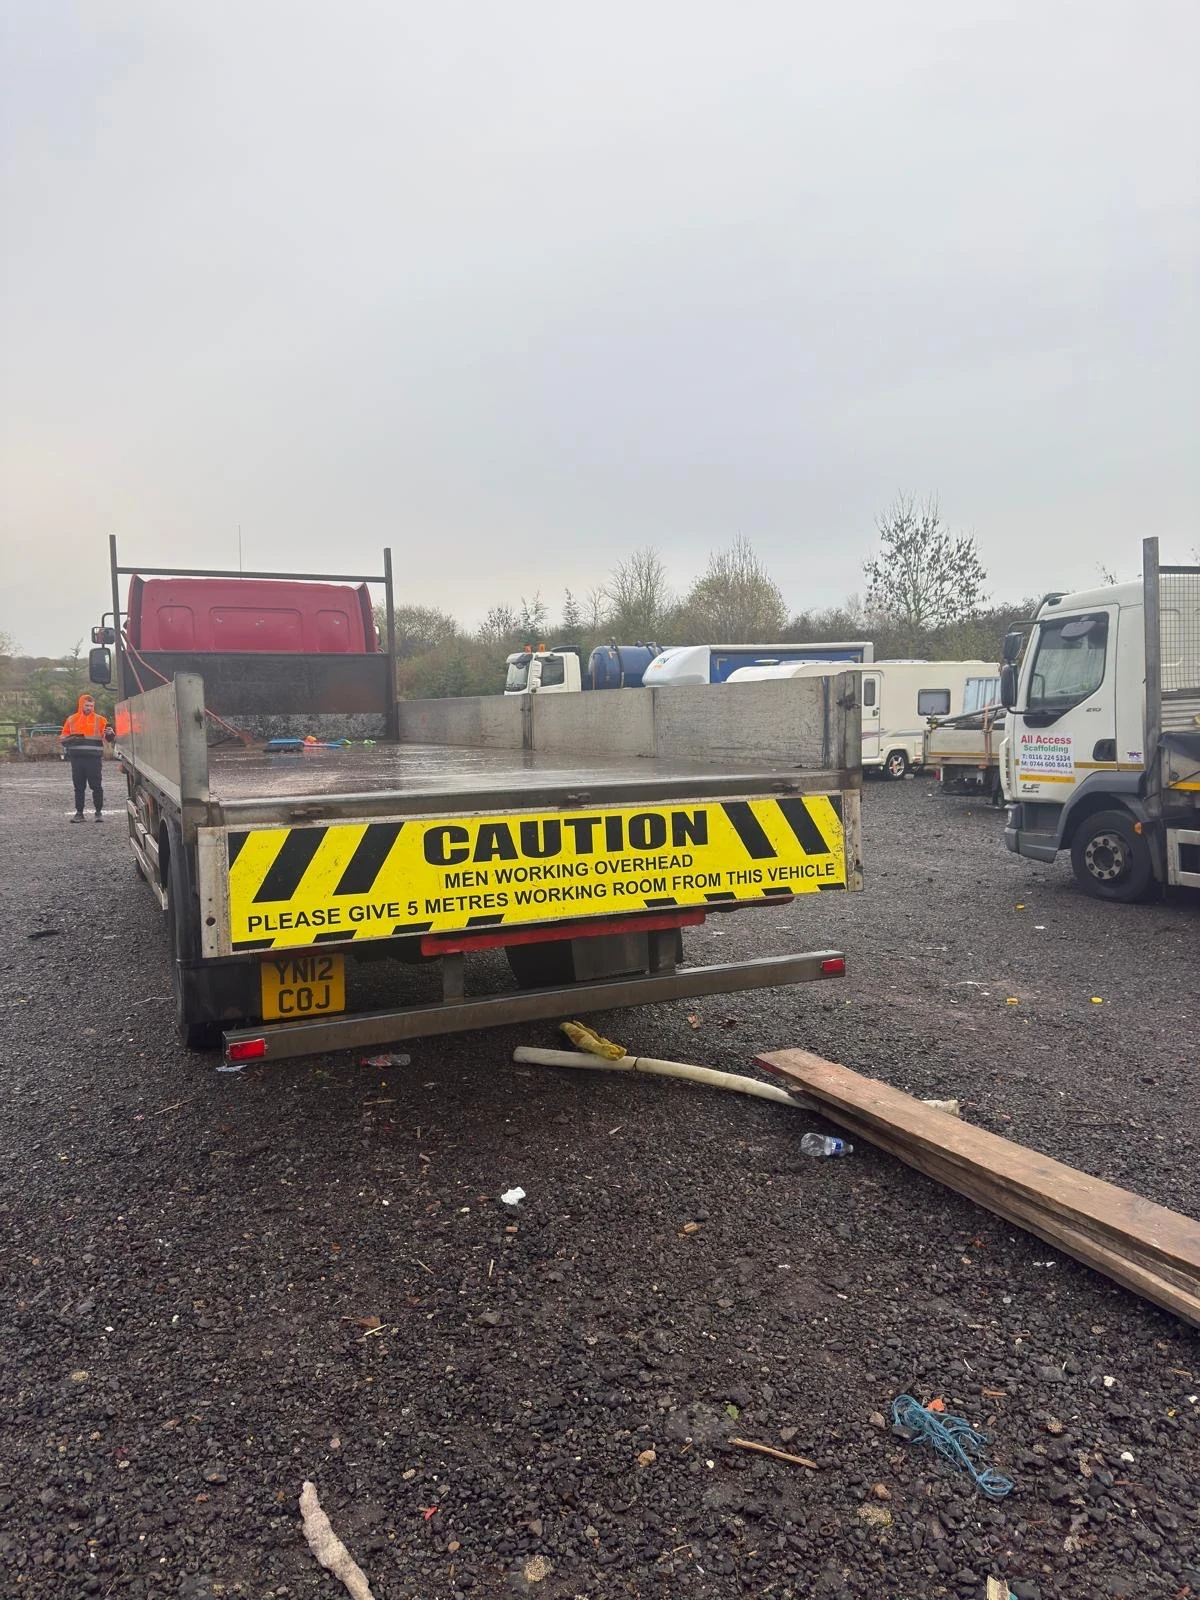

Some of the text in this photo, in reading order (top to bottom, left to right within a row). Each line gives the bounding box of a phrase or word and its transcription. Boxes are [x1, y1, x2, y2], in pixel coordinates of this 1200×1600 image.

[1021, 735, 1072, 745] All Access
[1023, 745, 1069, 754] Scaffolding
[423, 810, 709, 866] CAUTION
[445, 853, 693, 889] MEN WORKING OVERHEAD
[248, 863, 836, 932] PLEASE GIVE 5 METRES WORKING ROOM FROM THIS VEHICLE
[274, 957, 334, 985] YN12
[278, 985, 330, 1014] COJ
